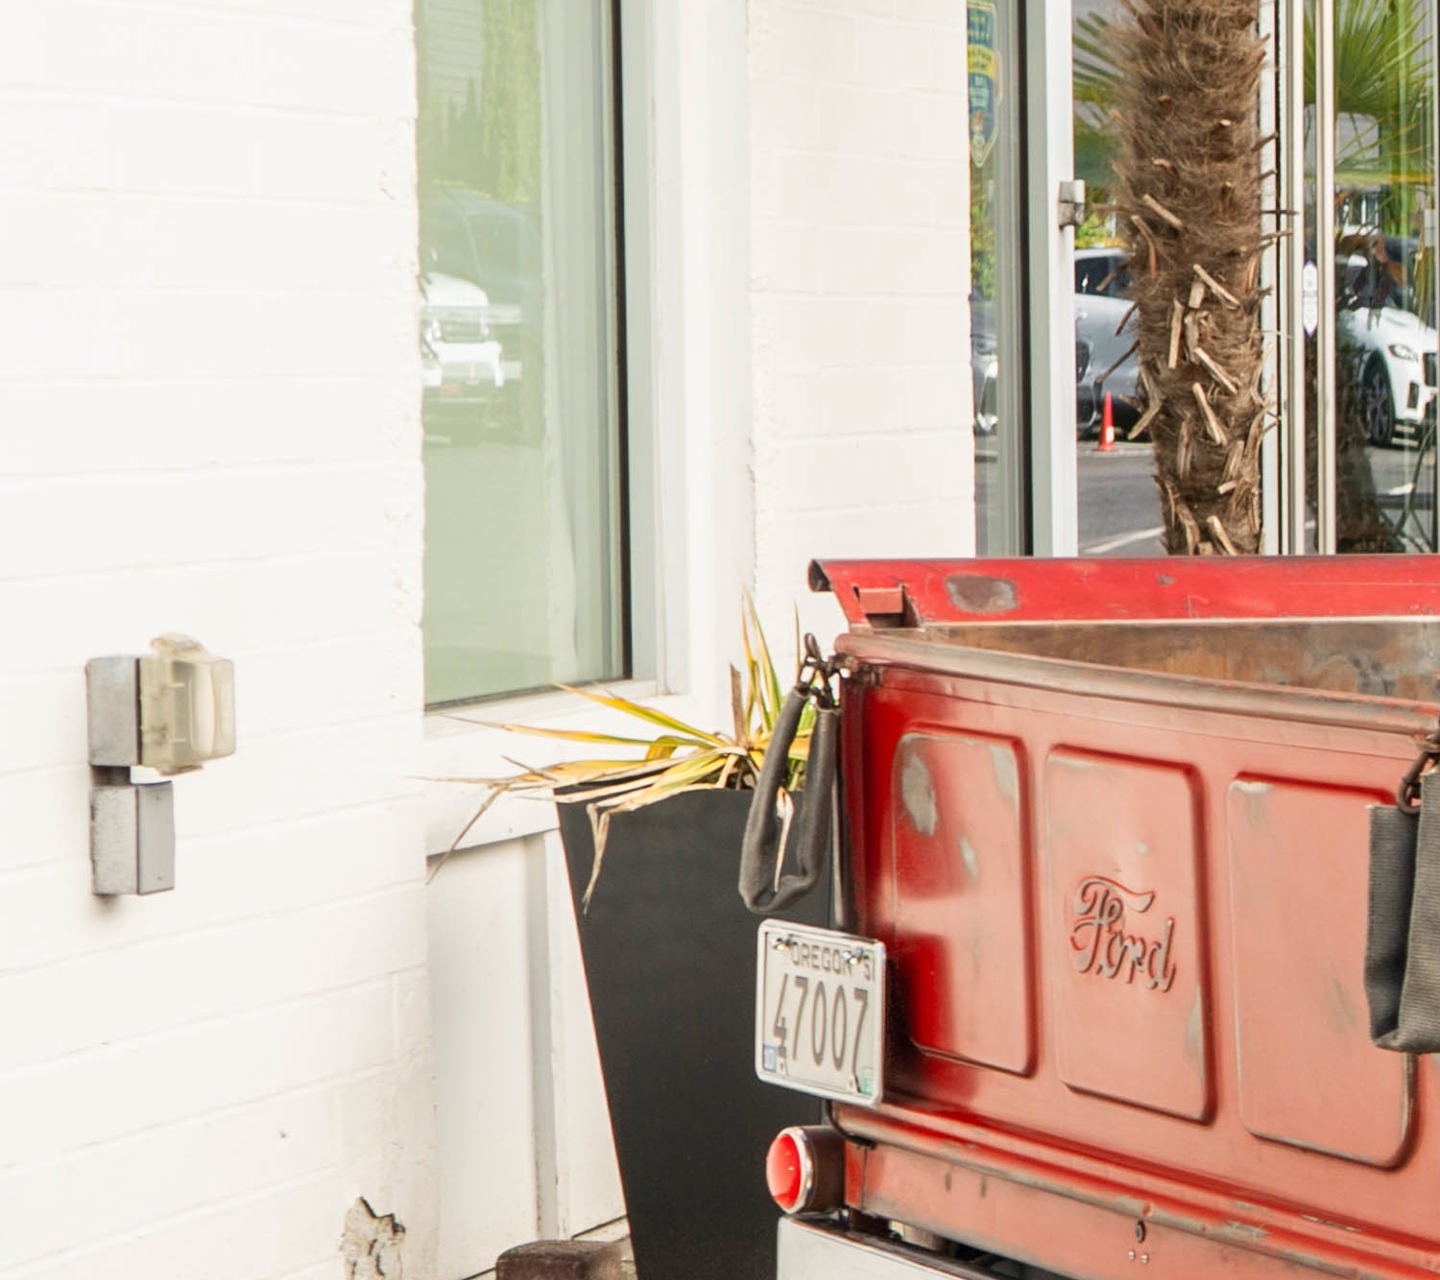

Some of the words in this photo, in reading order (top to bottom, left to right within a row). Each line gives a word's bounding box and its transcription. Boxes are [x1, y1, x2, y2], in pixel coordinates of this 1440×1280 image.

[790, 940, 855, 977] OREGON
[1070, 875, 1177, 993] Ford
[773, 973, 868, 1075] 47007
